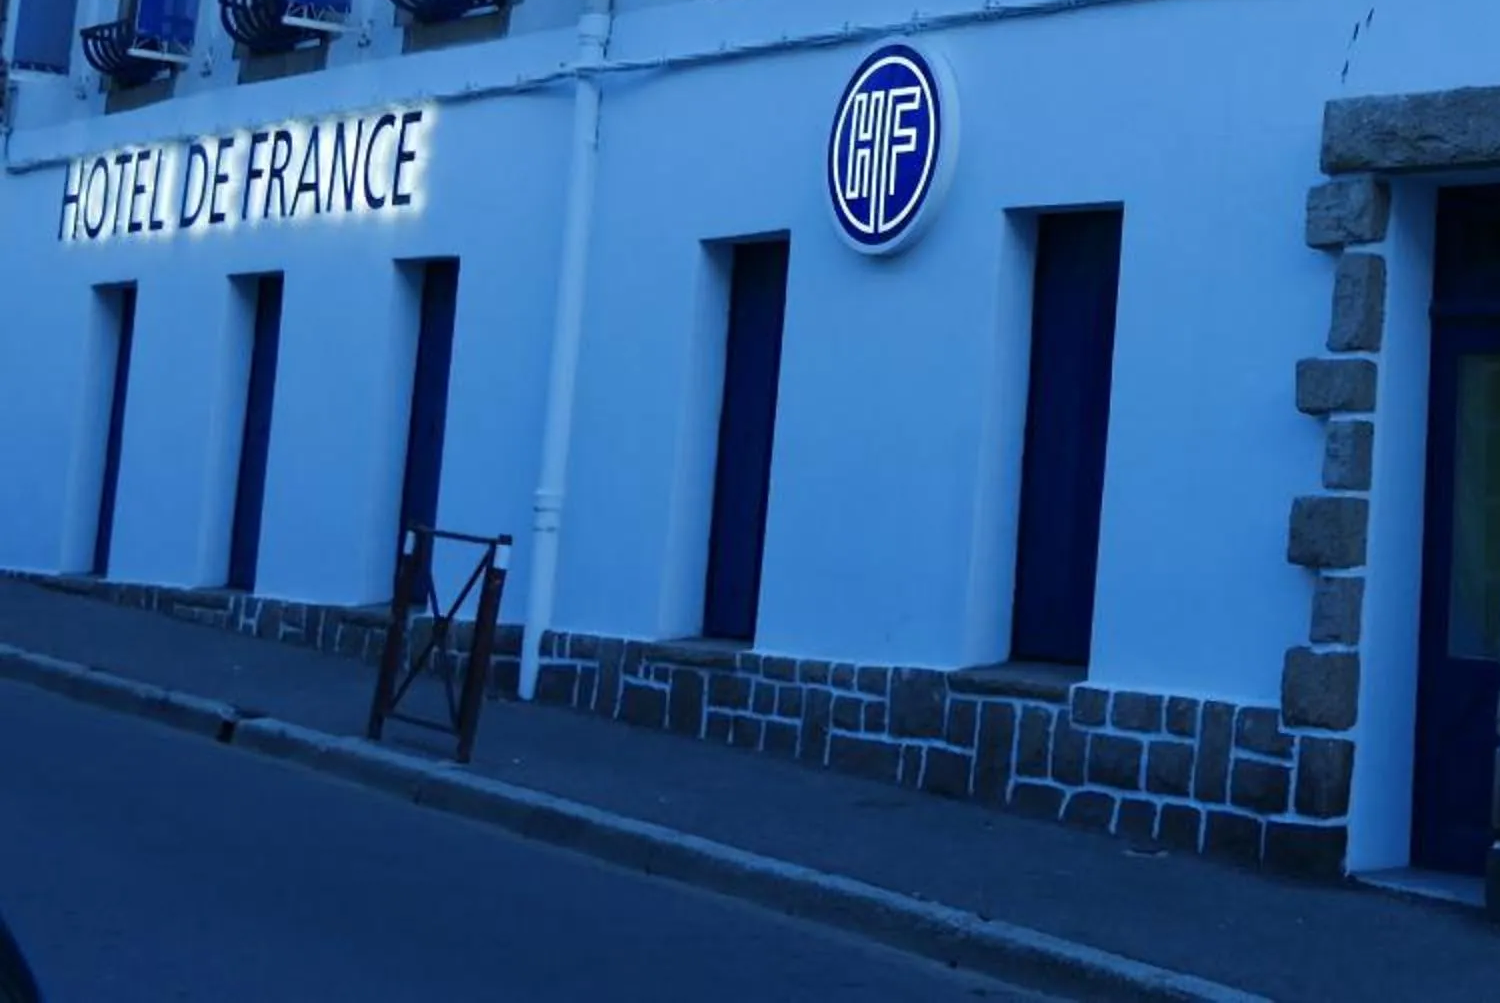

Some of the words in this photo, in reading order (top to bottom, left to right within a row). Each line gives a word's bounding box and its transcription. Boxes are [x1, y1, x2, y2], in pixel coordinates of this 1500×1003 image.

[58, 148, 164, 241] HOTEL
[179, 137, 234, 229] DE
[242, 110, 423, 220] FRANCE
